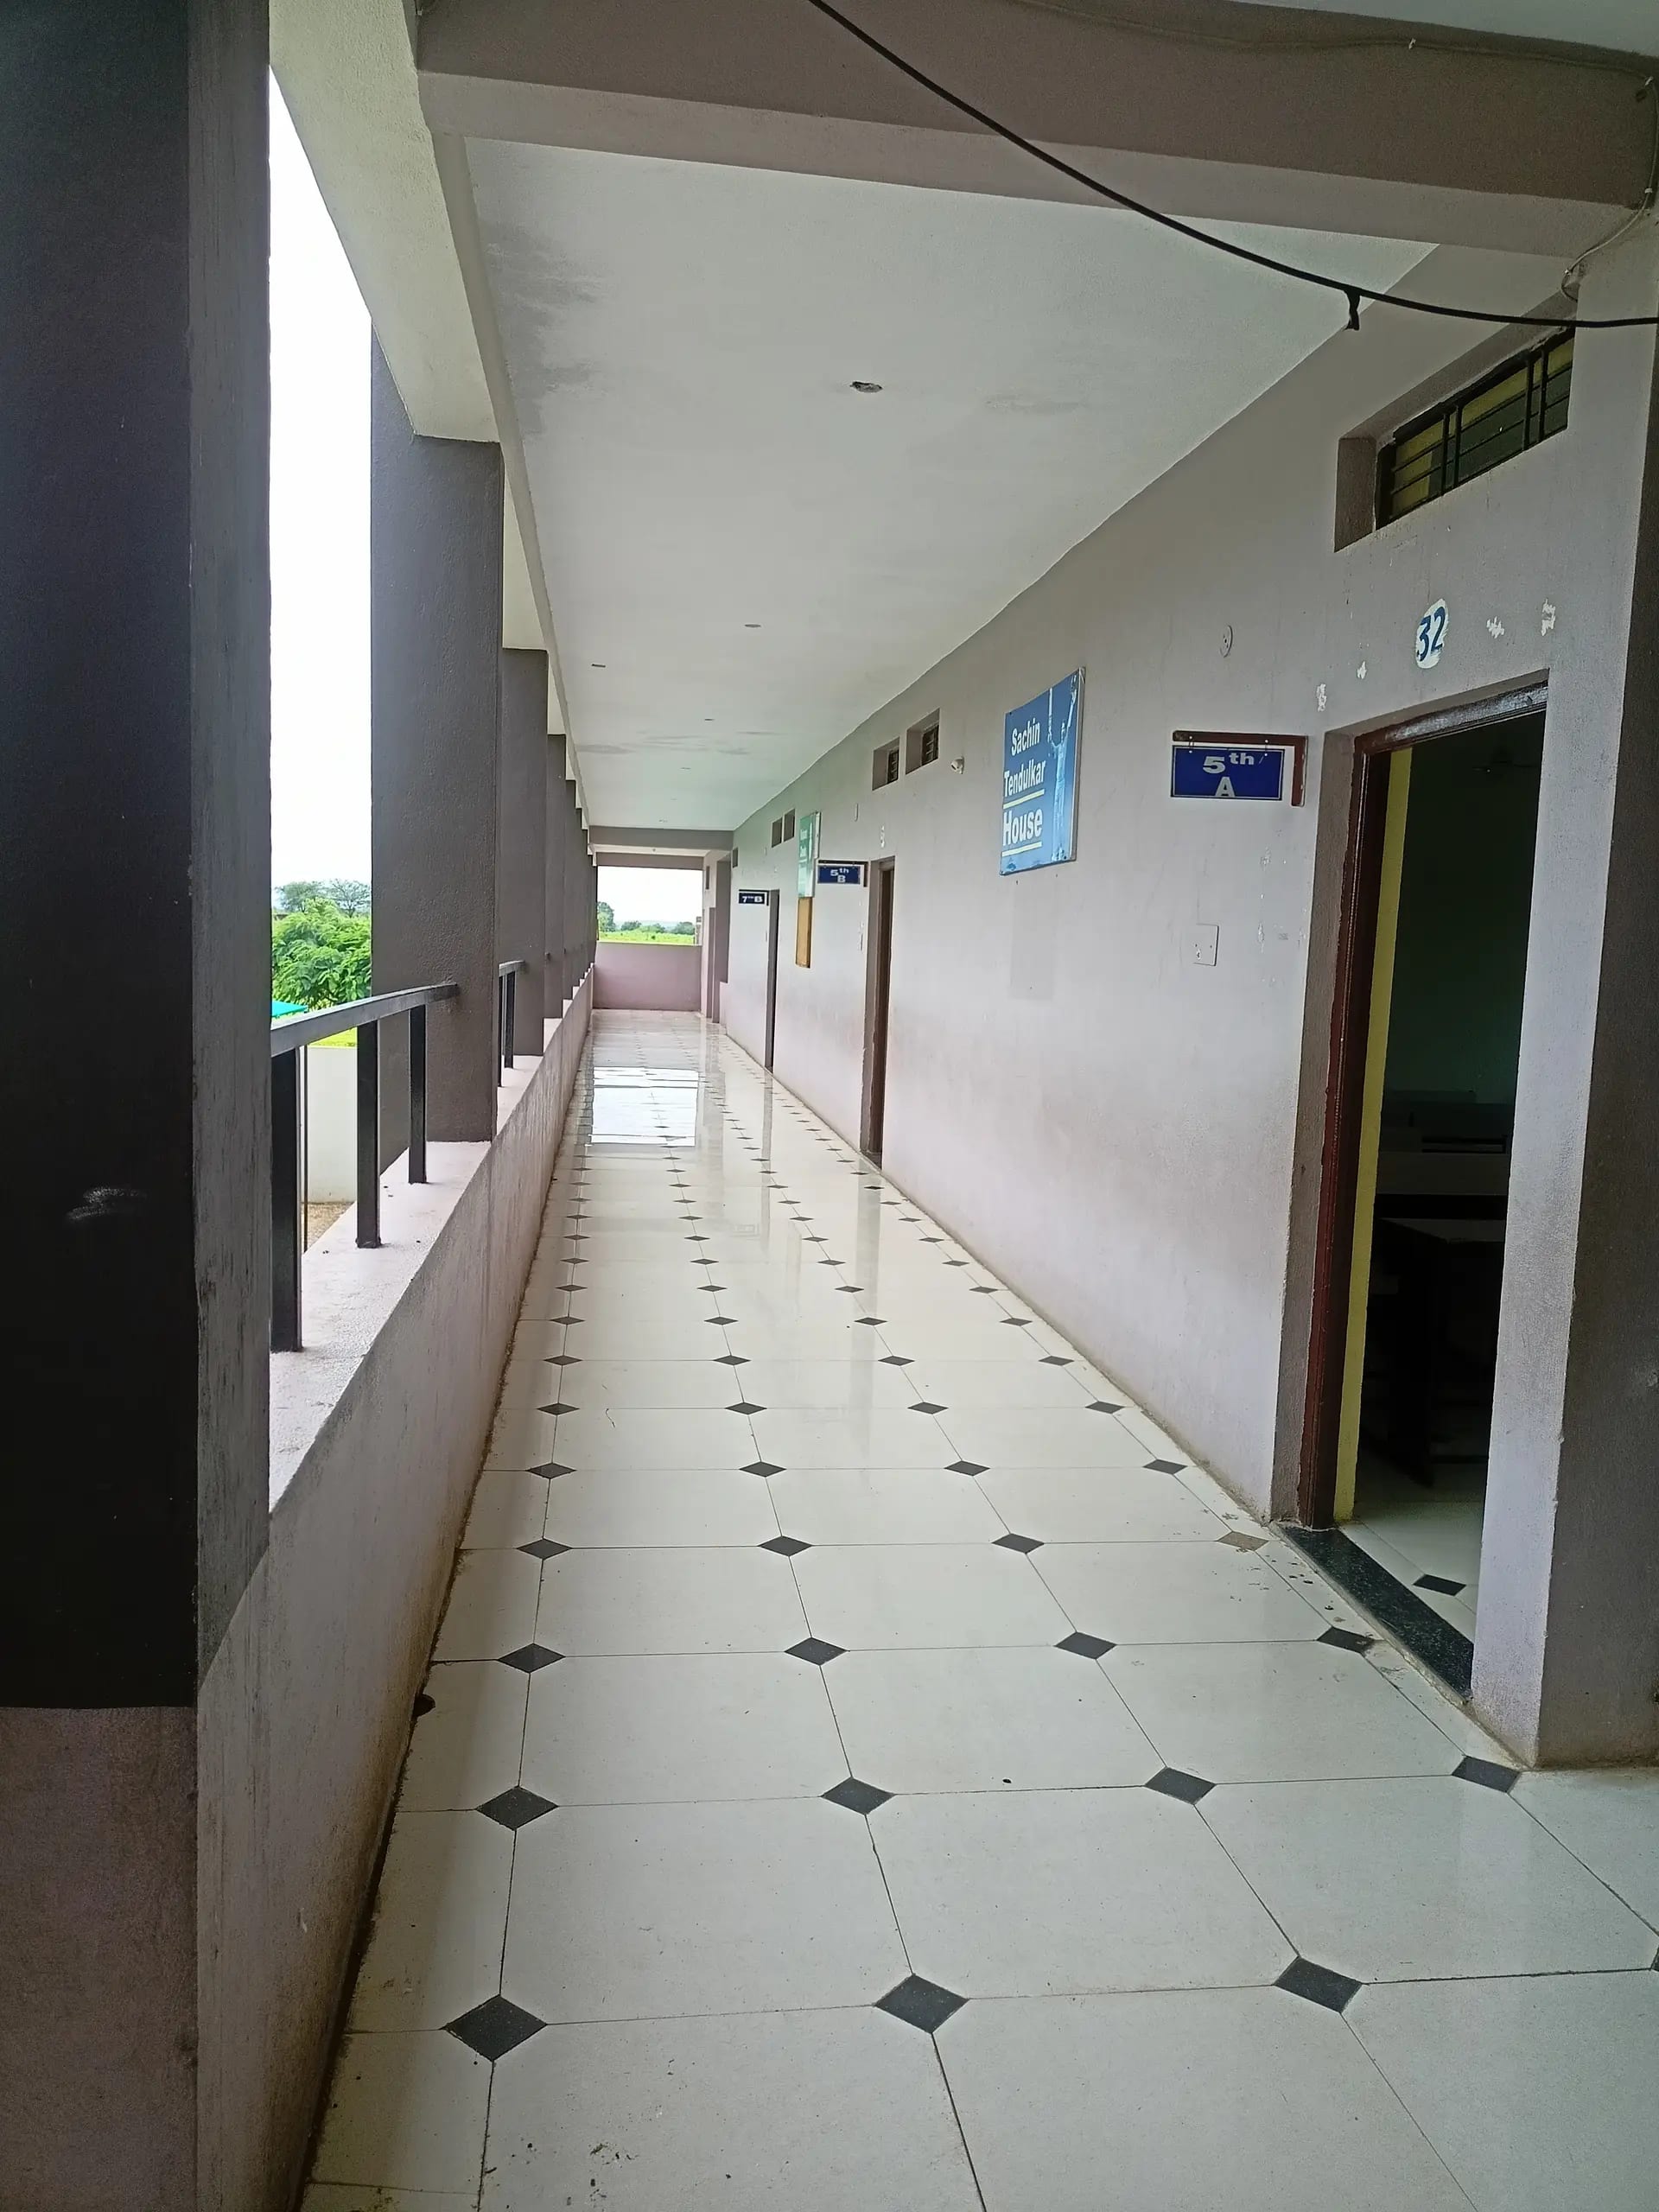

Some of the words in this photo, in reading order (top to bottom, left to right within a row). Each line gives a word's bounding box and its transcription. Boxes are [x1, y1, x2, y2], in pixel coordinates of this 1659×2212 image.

[1417, 607, 1446, 661] 32
[1011, 717, 1040, 757] Sachin
[1004, 760, 1046, 798] Tendulkar
[1203, 753, 1255, 774] 5th
[1215, 776, 1236, 798] A
[1002, 808, 1043, 846] House
[830, 868, 849, 876] 5th
